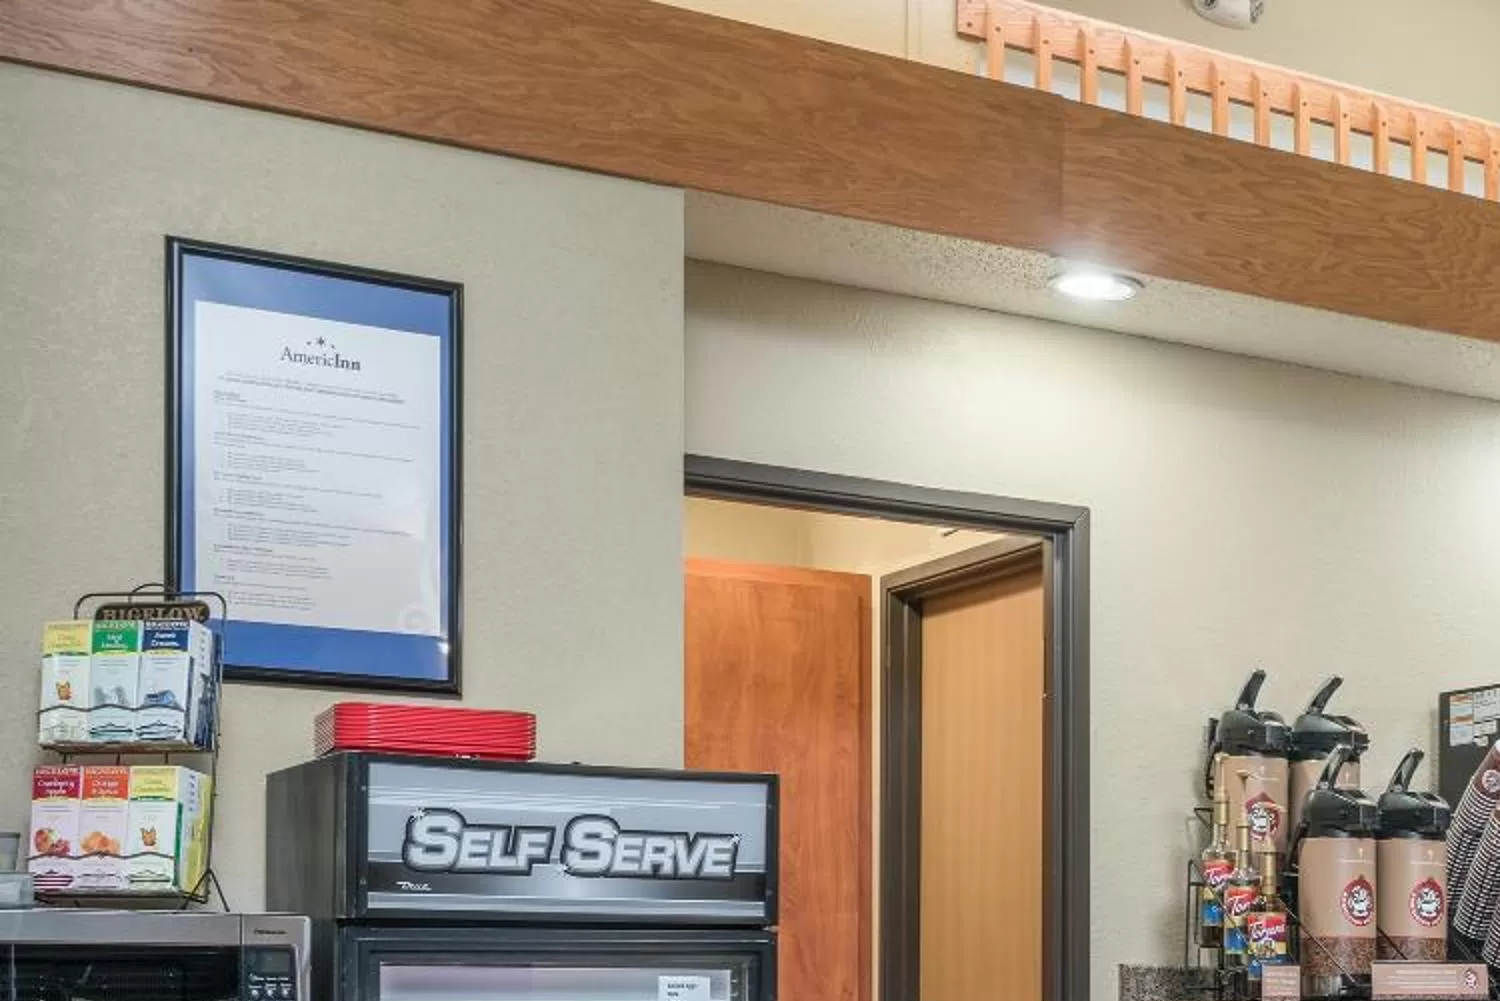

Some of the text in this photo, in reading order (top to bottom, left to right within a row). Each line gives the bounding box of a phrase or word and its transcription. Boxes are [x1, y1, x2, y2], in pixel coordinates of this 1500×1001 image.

[280, 346, 362, 371] AmericInn
[402, 807, 739, 881] SELF SERVE
